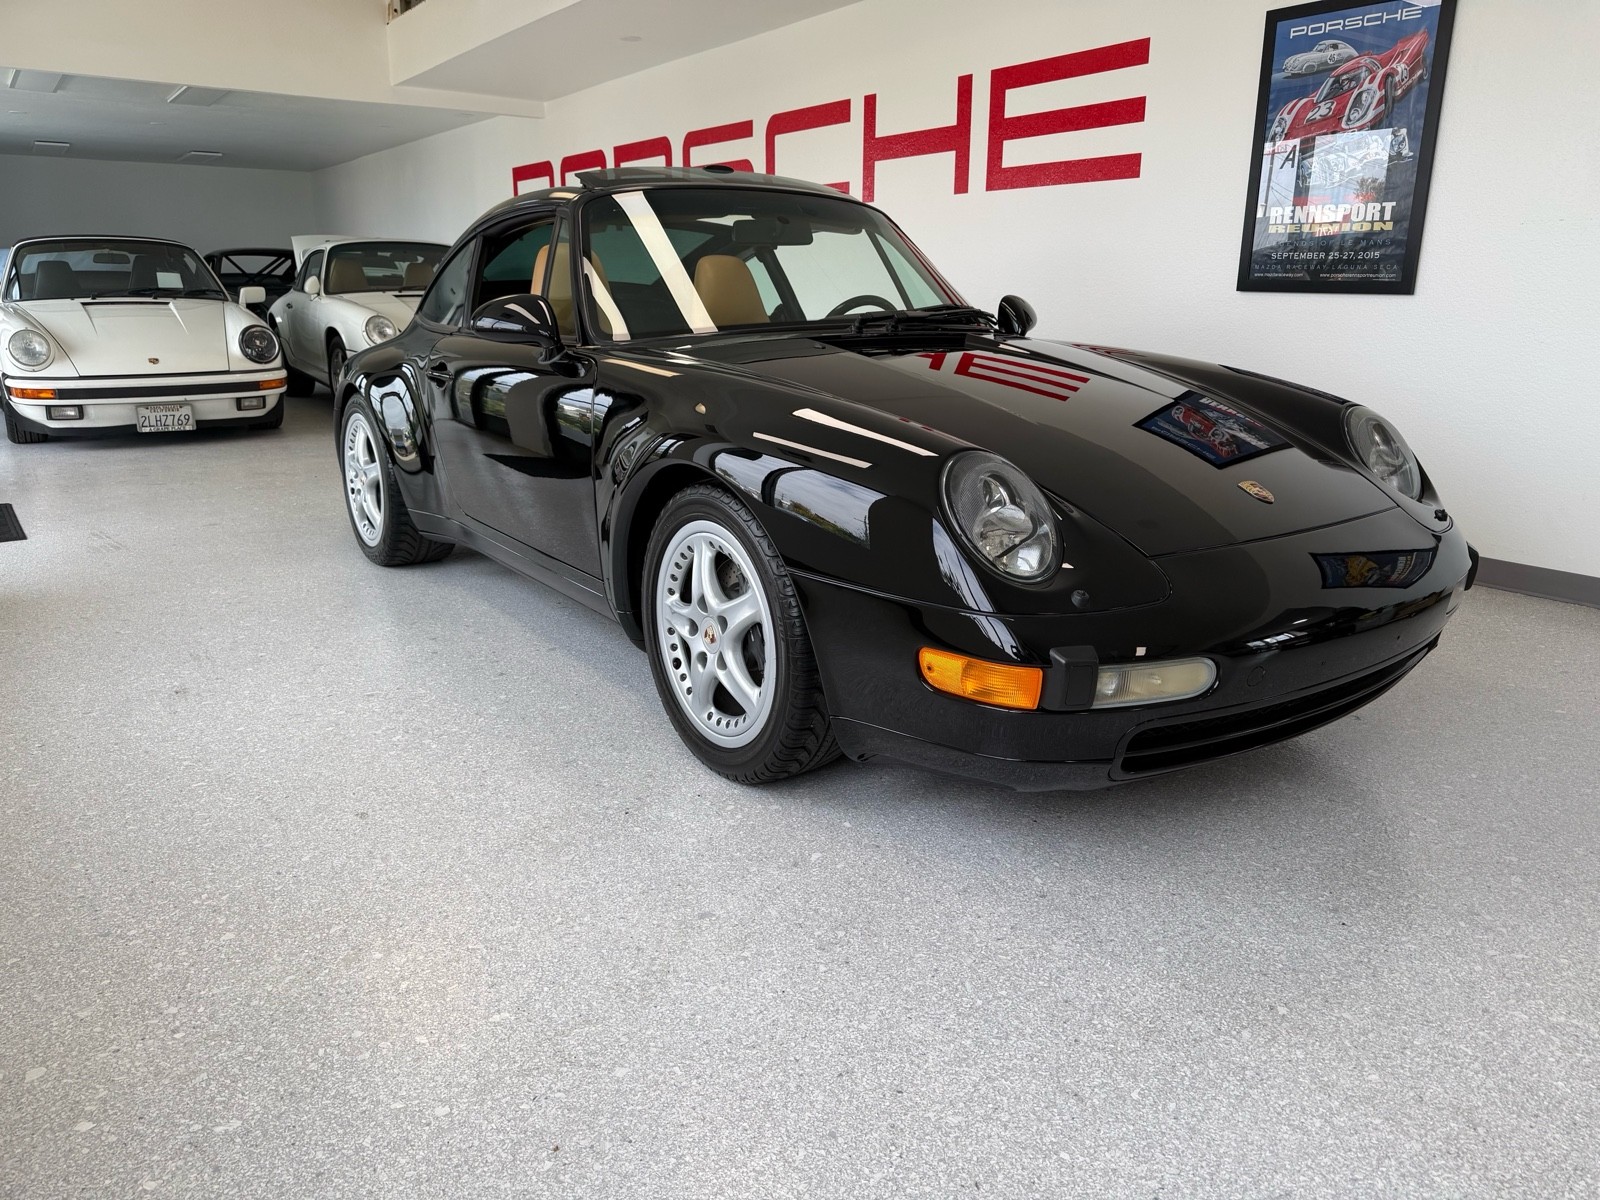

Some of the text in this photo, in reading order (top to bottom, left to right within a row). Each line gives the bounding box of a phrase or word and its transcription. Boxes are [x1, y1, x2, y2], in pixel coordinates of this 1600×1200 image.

[1290, 6, 1422, 39] PORSCHE
[1306, 101, 1333, 122] 23
[1269, 202, 1396, 224] RENNSPORT
[1268, 221, 1394, 234] REUNION
[1271, 251, 1380, 260] SEPTEMBER 25-27, 2015
[141, 414, 190, 427] 2LHZ769
